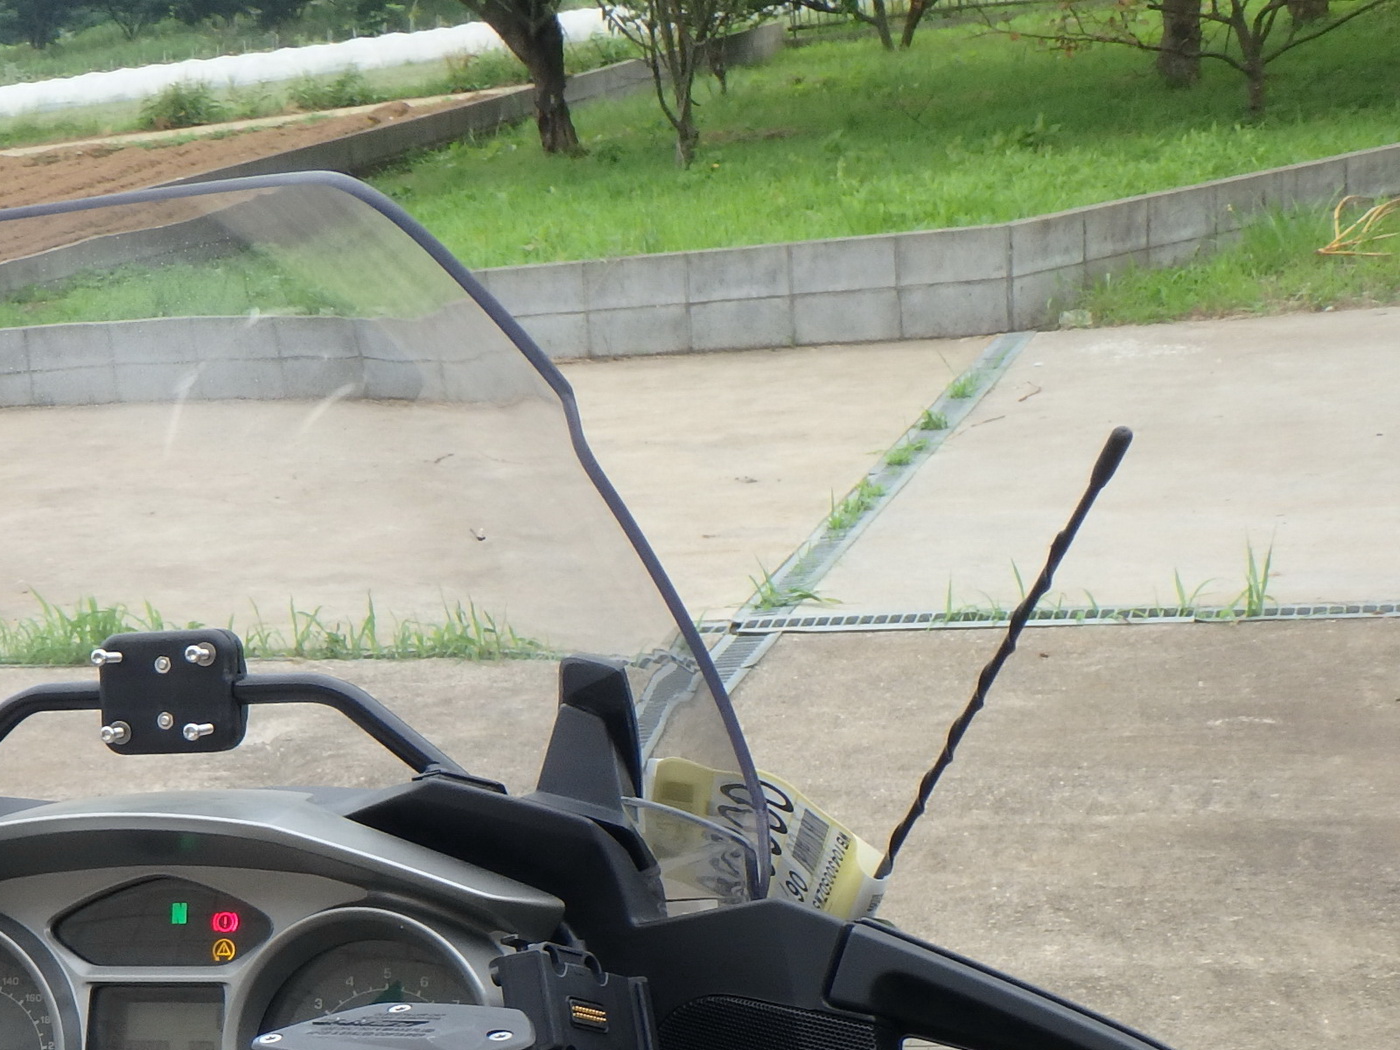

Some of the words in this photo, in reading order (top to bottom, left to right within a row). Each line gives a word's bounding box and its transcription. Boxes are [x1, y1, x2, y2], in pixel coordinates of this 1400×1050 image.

[383, 967, 392, 979] 5
[2, 976, 20, 986] 140
[345, 976, 354, 987] 4
[420, 976, 430, 988] 6
[26, 993, 42, 1002] 160
[314, 997, 323, 1009] 3
